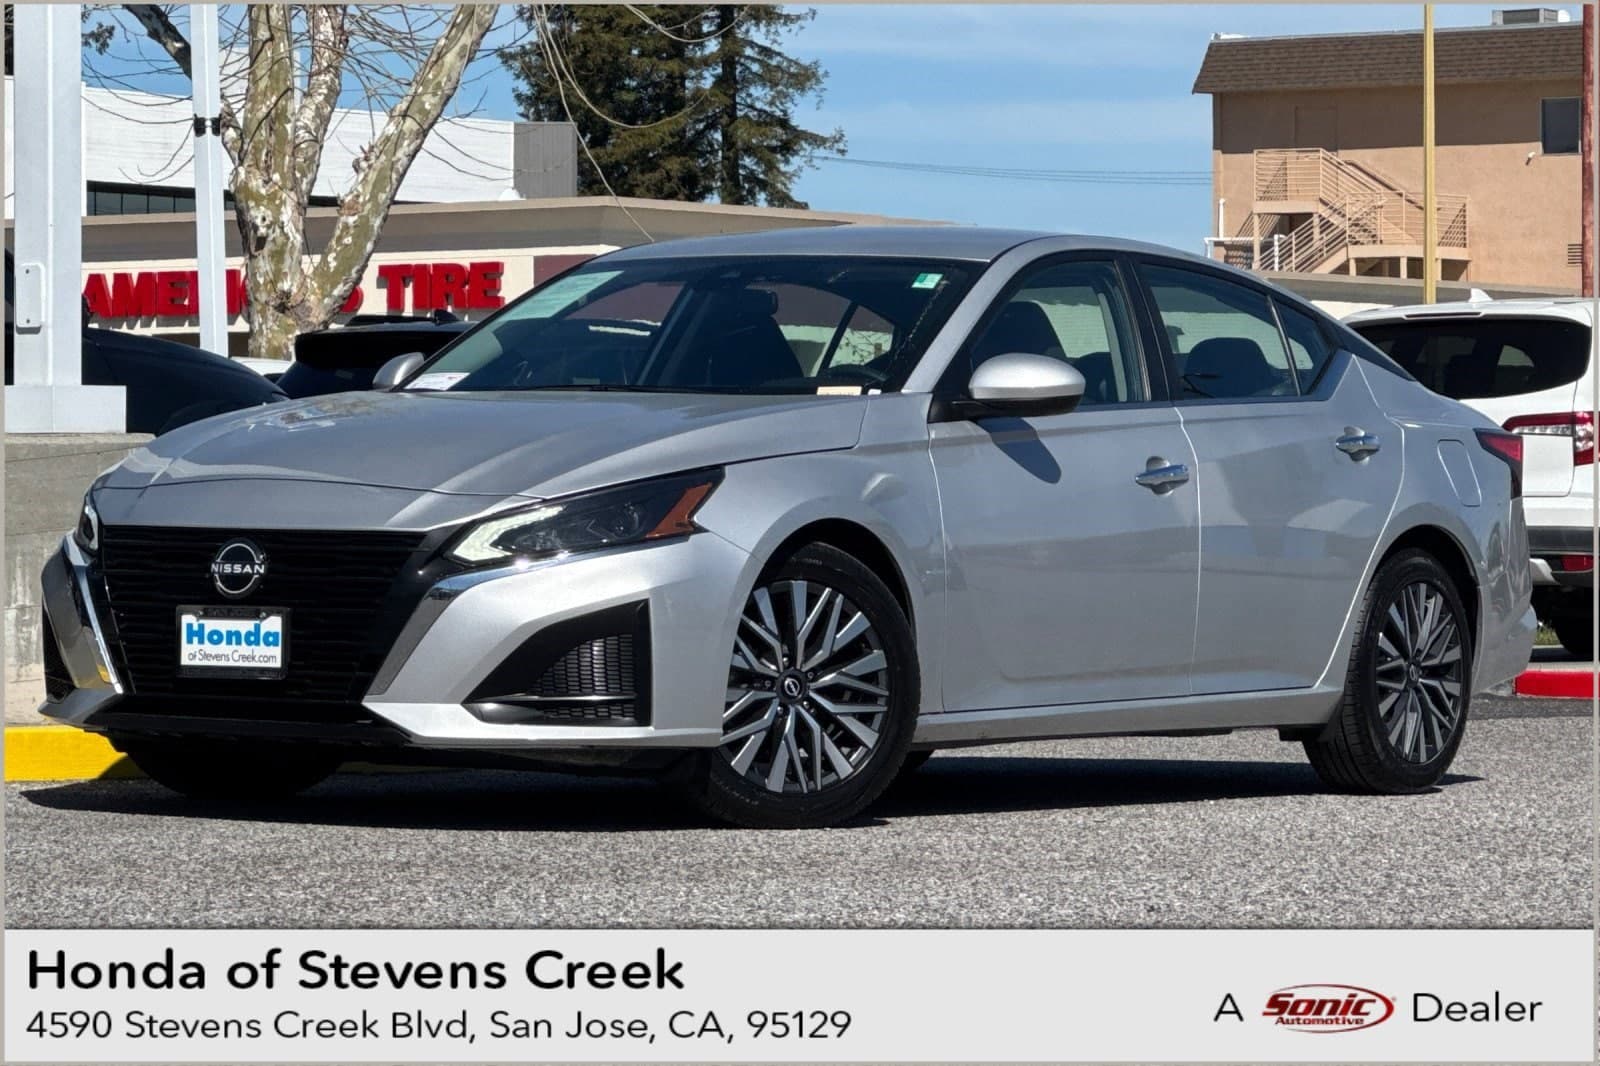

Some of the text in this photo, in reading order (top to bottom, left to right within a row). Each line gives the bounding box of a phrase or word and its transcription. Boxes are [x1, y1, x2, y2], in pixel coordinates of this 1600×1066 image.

[378, 261, 505, 311] TIRE
[211, 562, 265, 574] NISSAN
[185, 623, 280, 647] Honda
[188, 651, 197, 661] of
